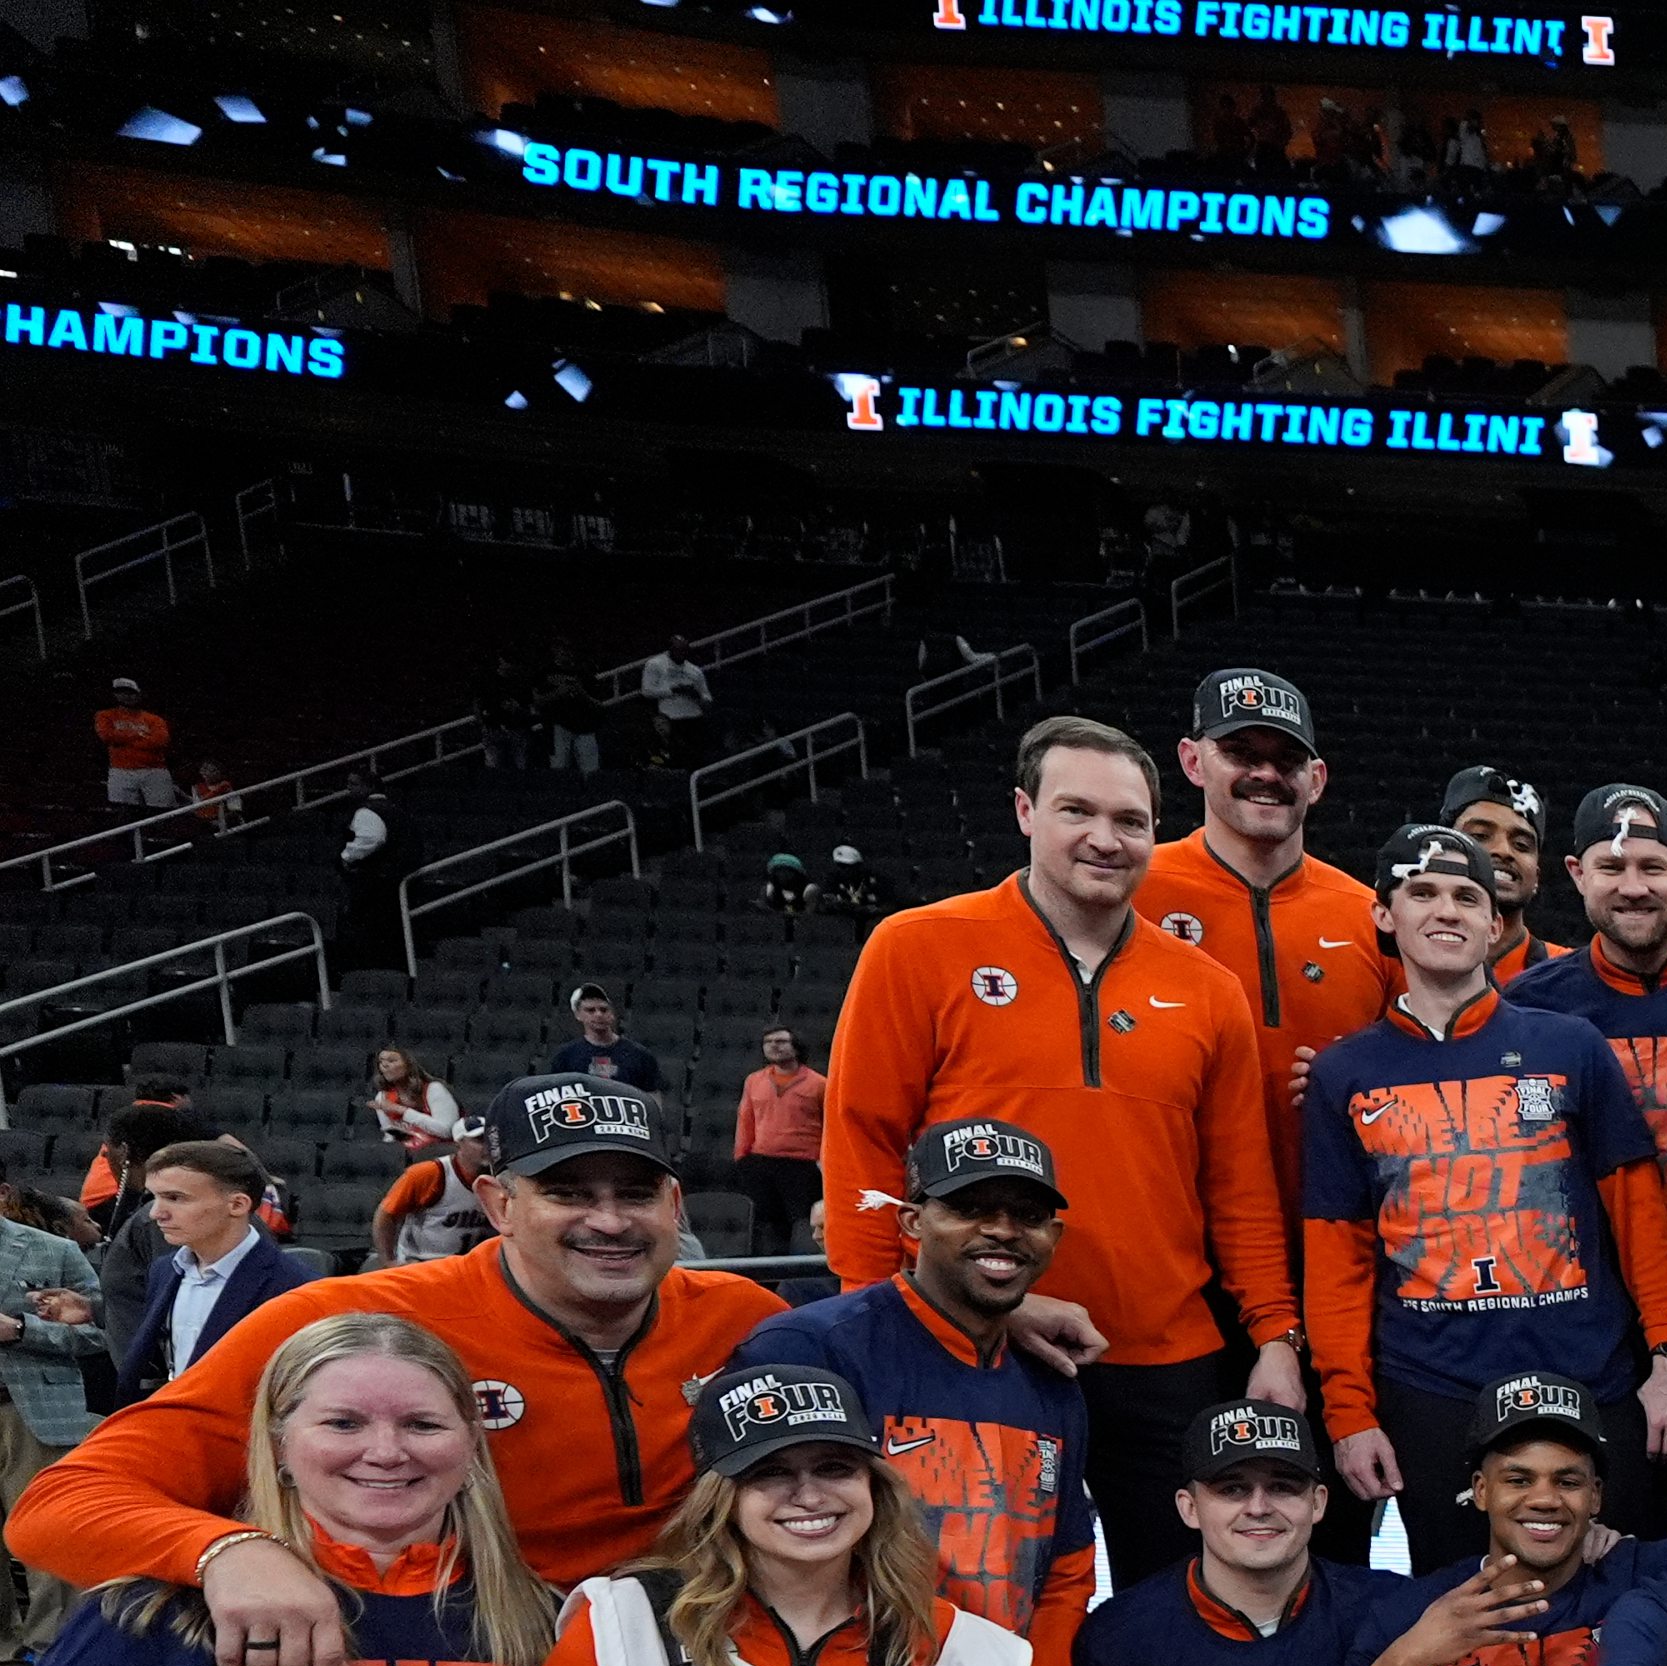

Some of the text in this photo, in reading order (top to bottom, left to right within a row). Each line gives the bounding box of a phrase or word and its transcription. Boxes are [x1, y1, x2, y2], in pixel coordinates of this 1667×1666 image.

[978, 0, 1182, 35] ILLINOIS
[1195, 0, 1410, 48] FIGHTING
[1422, 13, 1566, 58] ILLINI
[522, 143, 1330, 239] SOUTH REGIONAL CHAMPIONS
[0, 303, 345, 379] HAMPIONS
[896, 387, 1122, 435] ILLINOIS
[1135, 398, 1374, 447] FIGHTING
[1386, 410, 1545, 456] ILLINI
[1220, 676, 1263, 693] FINAL
[525, 1083, 590, 1112] FINAL
[528, 1096, 651, 1144] FOUR
[943, 1124, 998, 1147] FINAL
[1420, 1286, 1589, 1314] SOUTH REGIONAL CHAMPS
[719, 1374, 781, 1411] FINAL
[1497, 1376, 1540, 1395] FINAL
[723, 1383, 847, 1441] FOUR
[1211, 1406, 1256, 1431] FINAL
